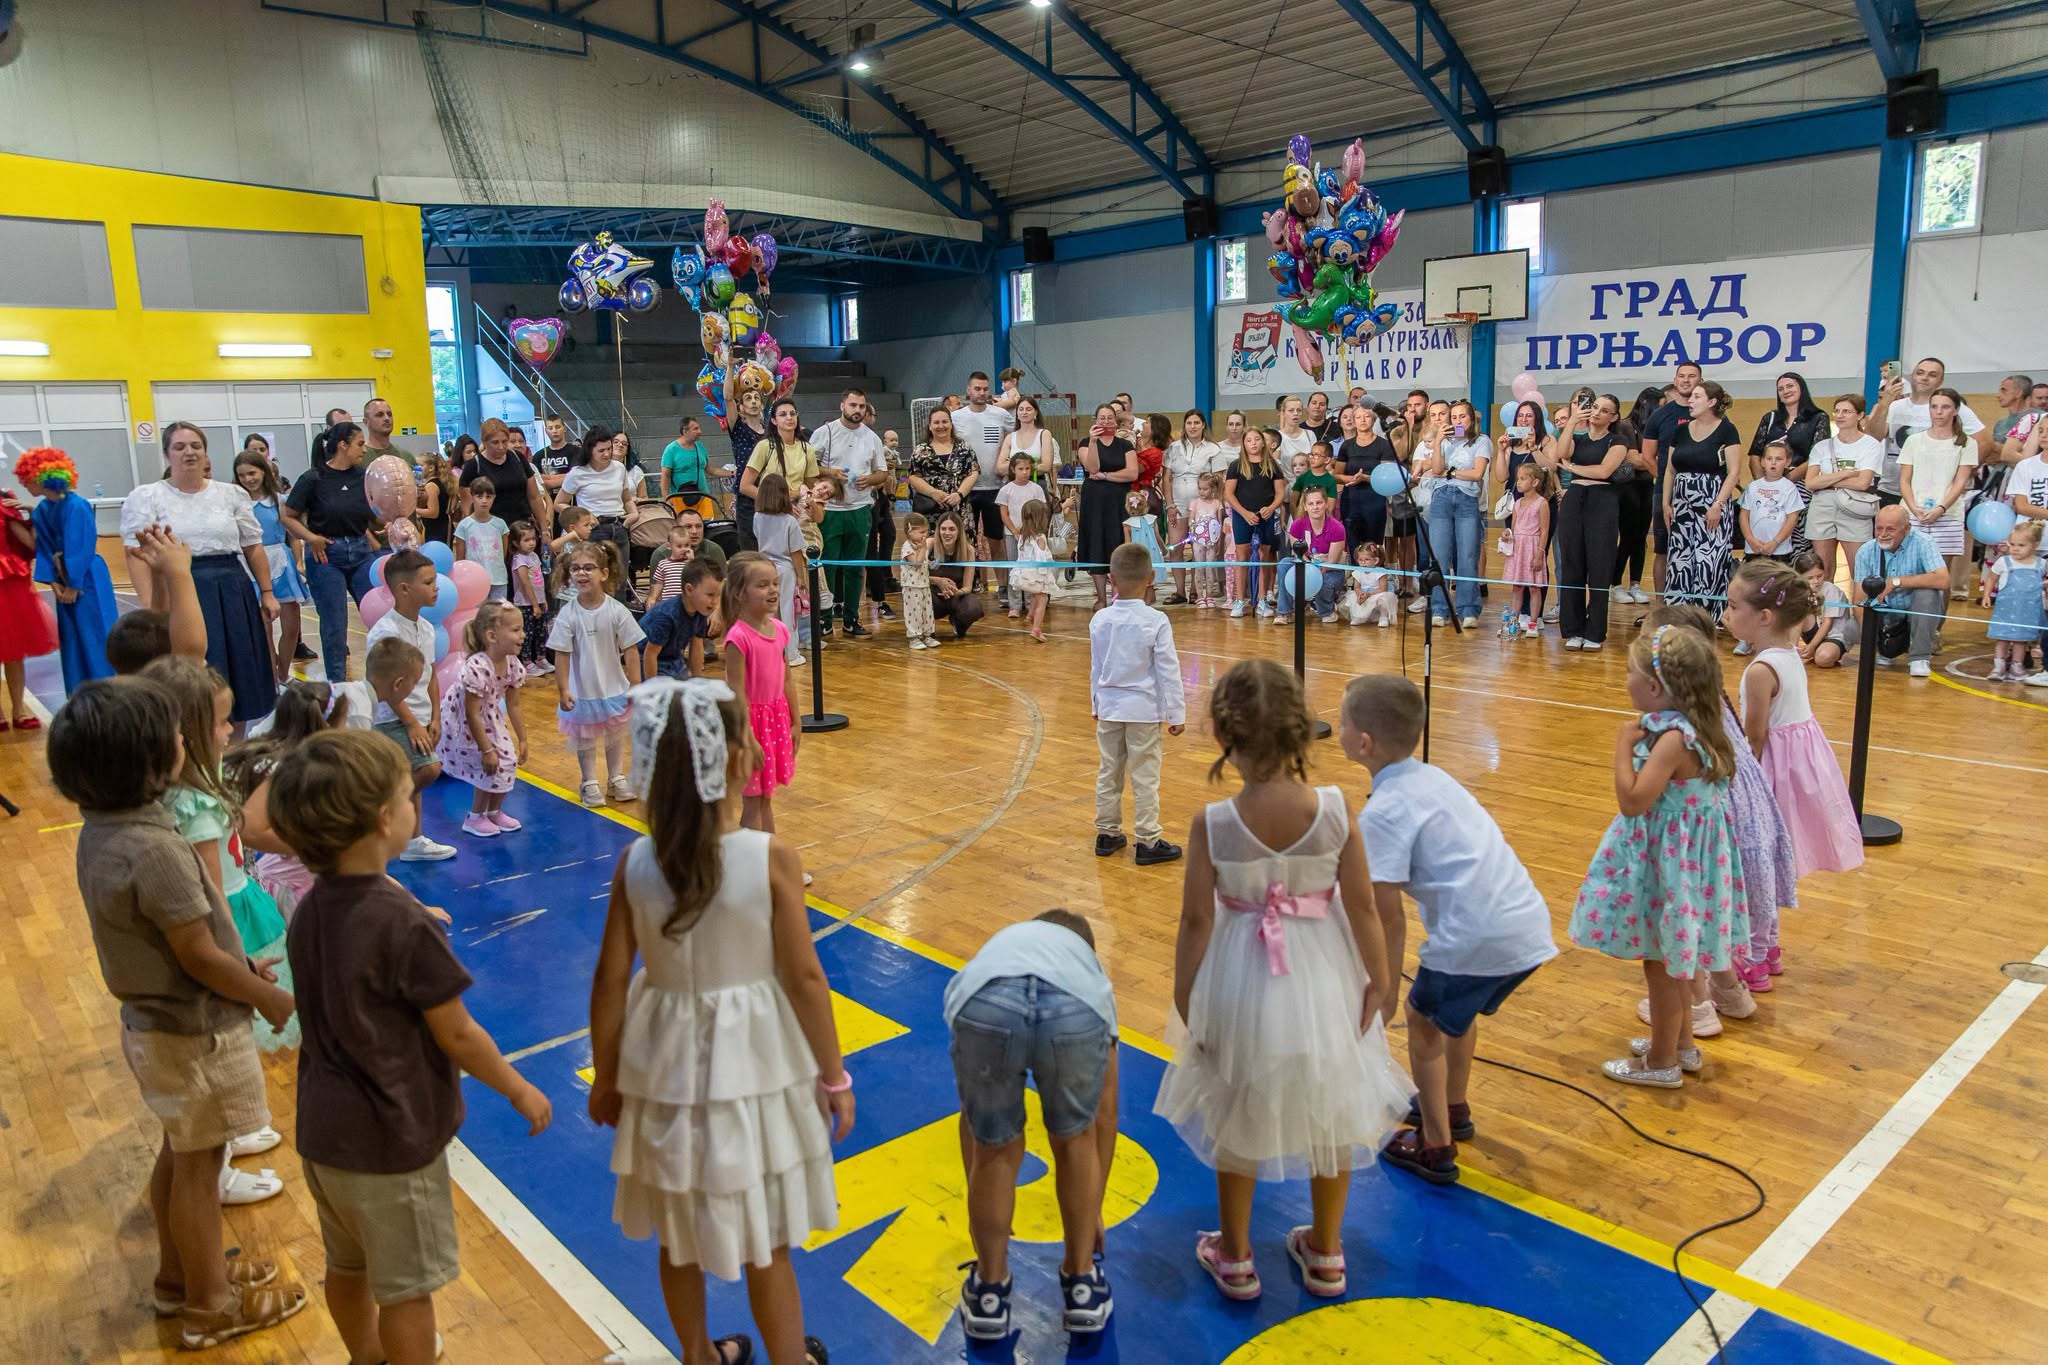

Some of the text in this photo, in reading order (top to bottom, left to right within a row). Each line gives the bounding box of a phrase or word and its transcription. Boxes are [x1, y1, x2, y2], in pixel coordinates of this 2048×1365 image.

[1590, 273, 1748, 321] ГРАД
[1525, 322, 1826, 371] ПРЊАВОР
[541, 456, 568, 466] NASA
